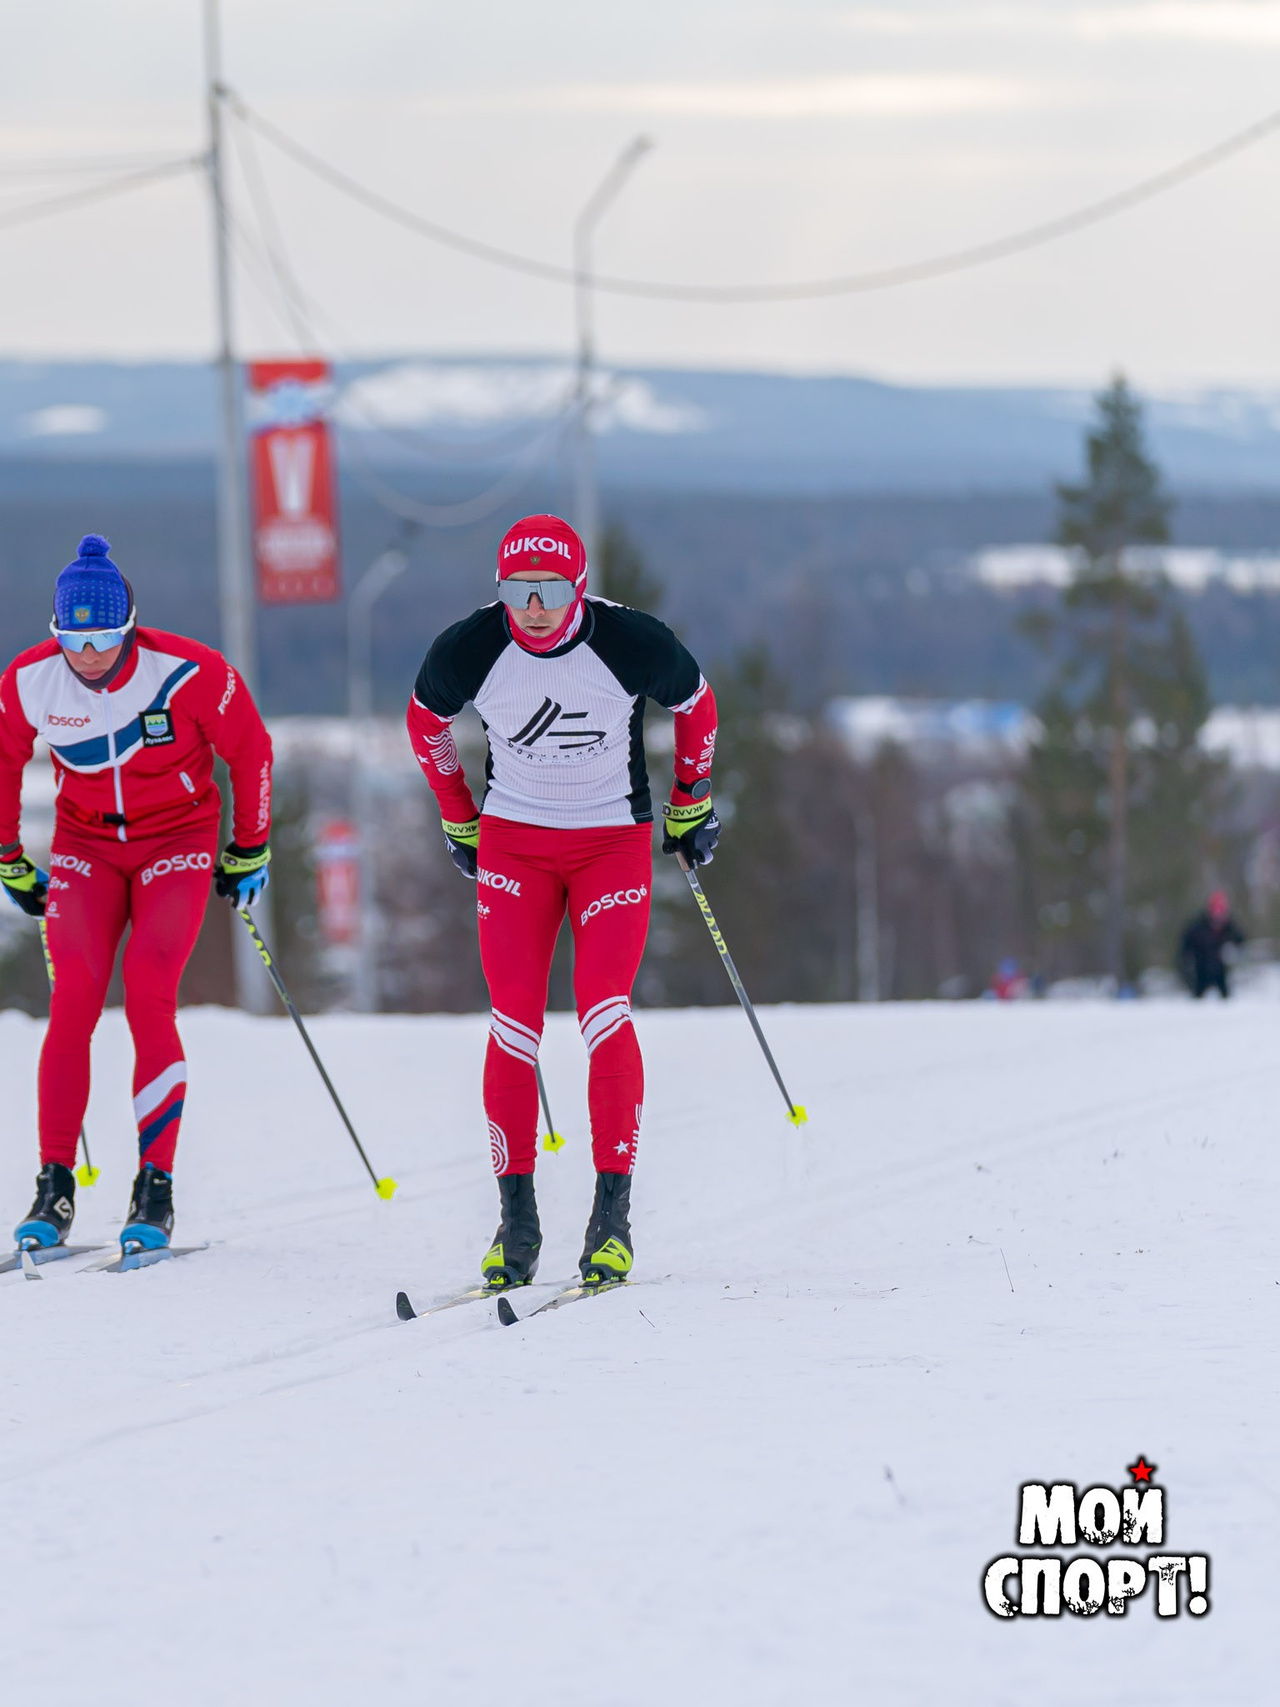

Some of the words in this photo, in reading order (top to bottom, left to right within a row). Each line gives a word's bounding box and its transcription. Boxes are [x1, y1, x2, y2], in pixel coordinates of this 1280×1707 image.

[503, 536, 572, 560] LUKOIL
[50, 852, 93, 878] KOIL
[140, 851, 212, 887] BOSCO
[477, 865, 521, 897] UKOIL
[580, 887, 642, 927] BOSCO
